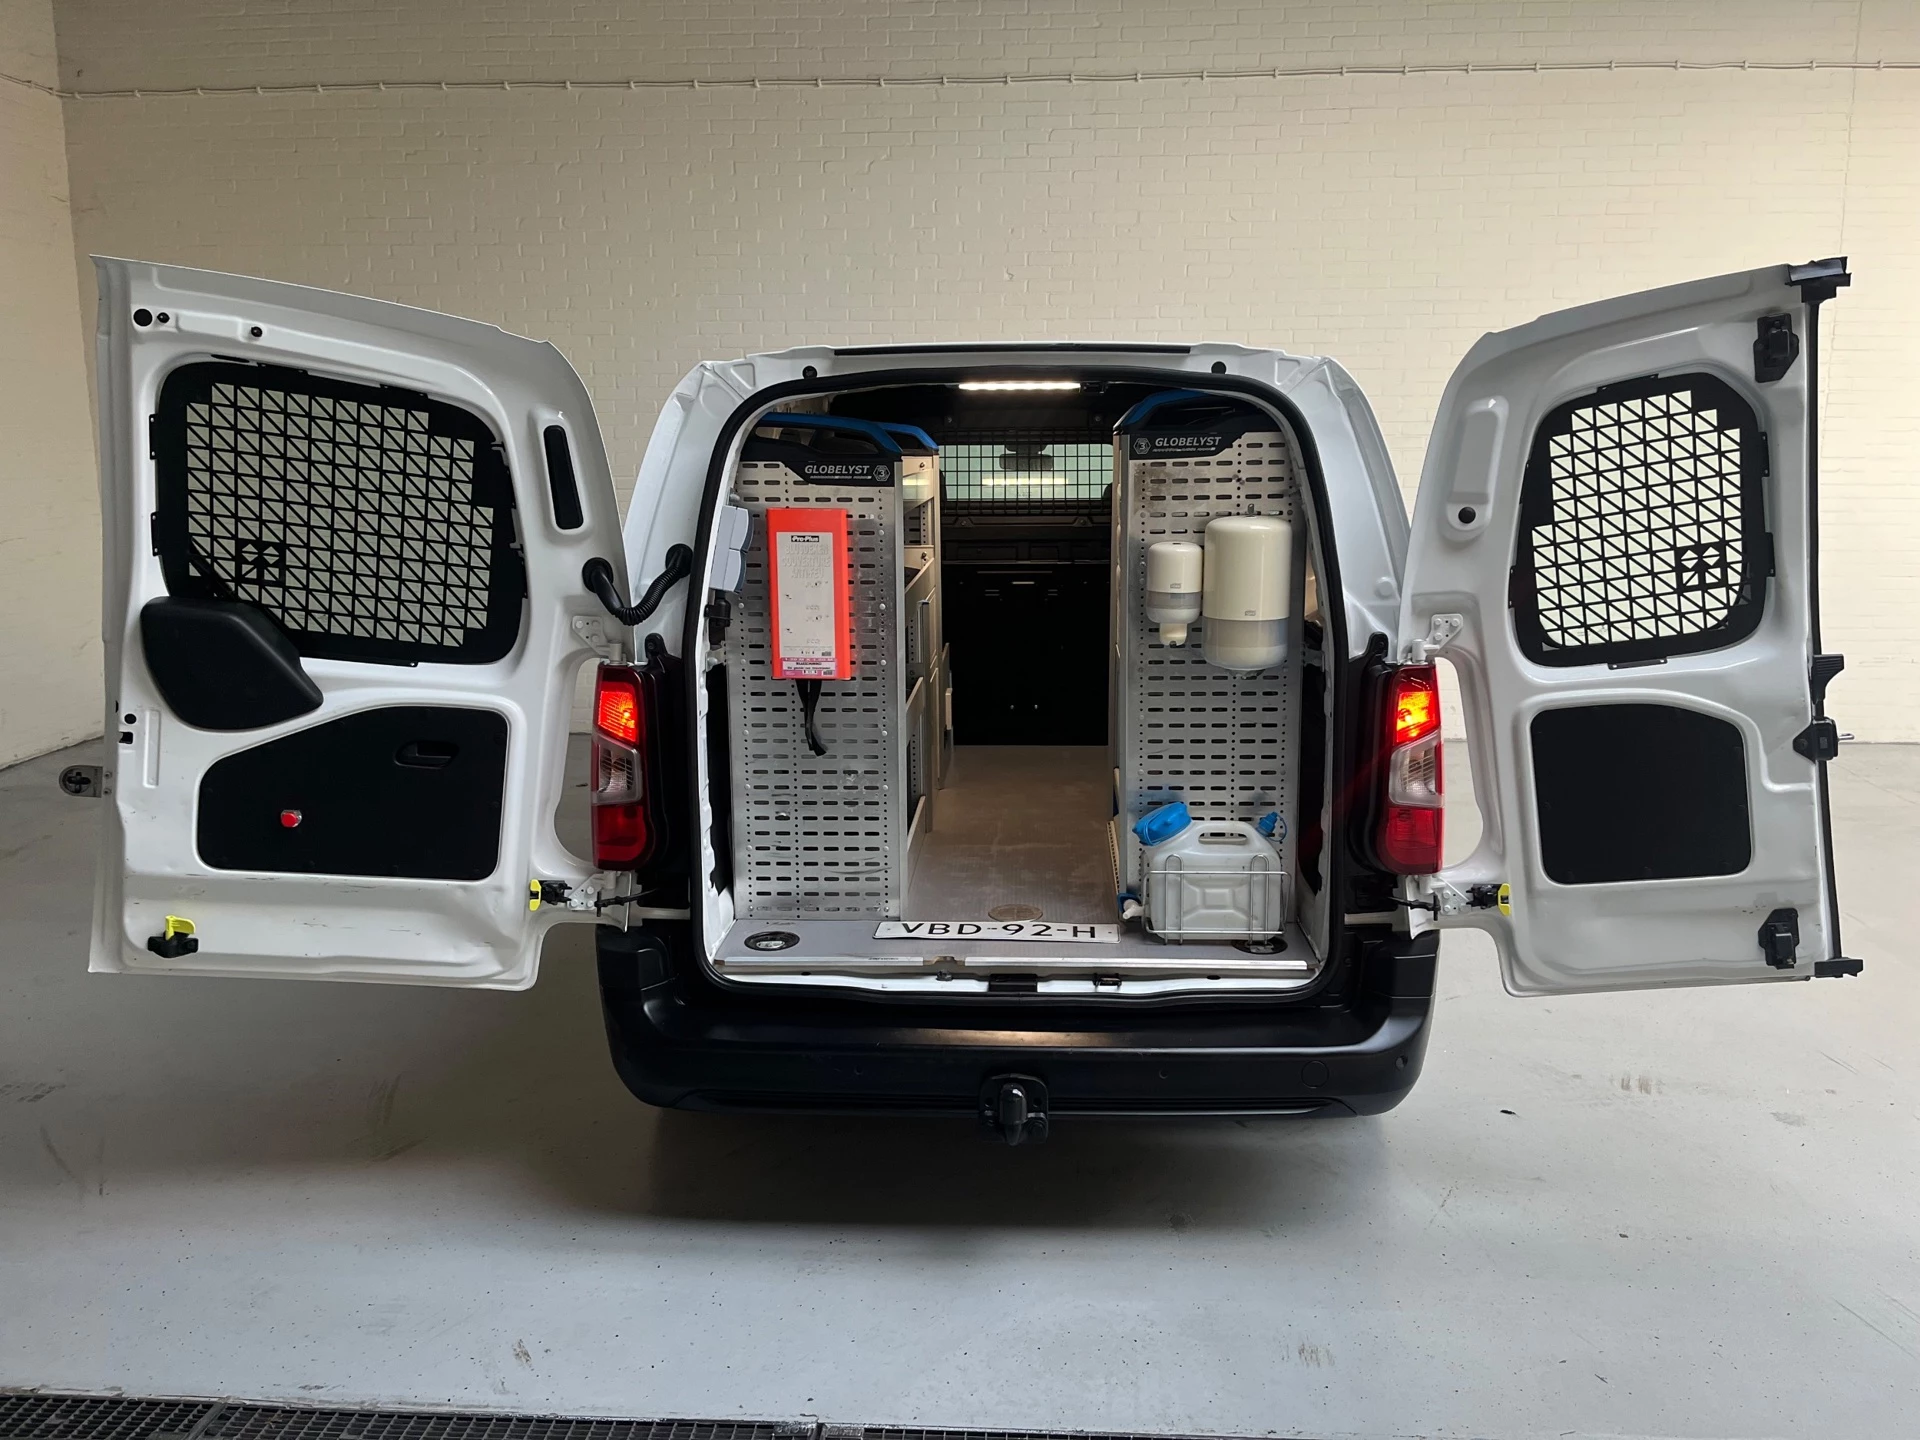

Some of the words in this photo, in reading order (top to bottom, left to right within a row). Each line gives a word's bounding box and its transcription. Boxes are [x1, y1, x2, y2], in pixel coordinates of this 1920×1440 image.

[1155, 437, 1222, 447] GLOBELYST
[804, 465, 870, 474] GLOBELYST
[901, 922, 1096, 939] VBD-92-H
